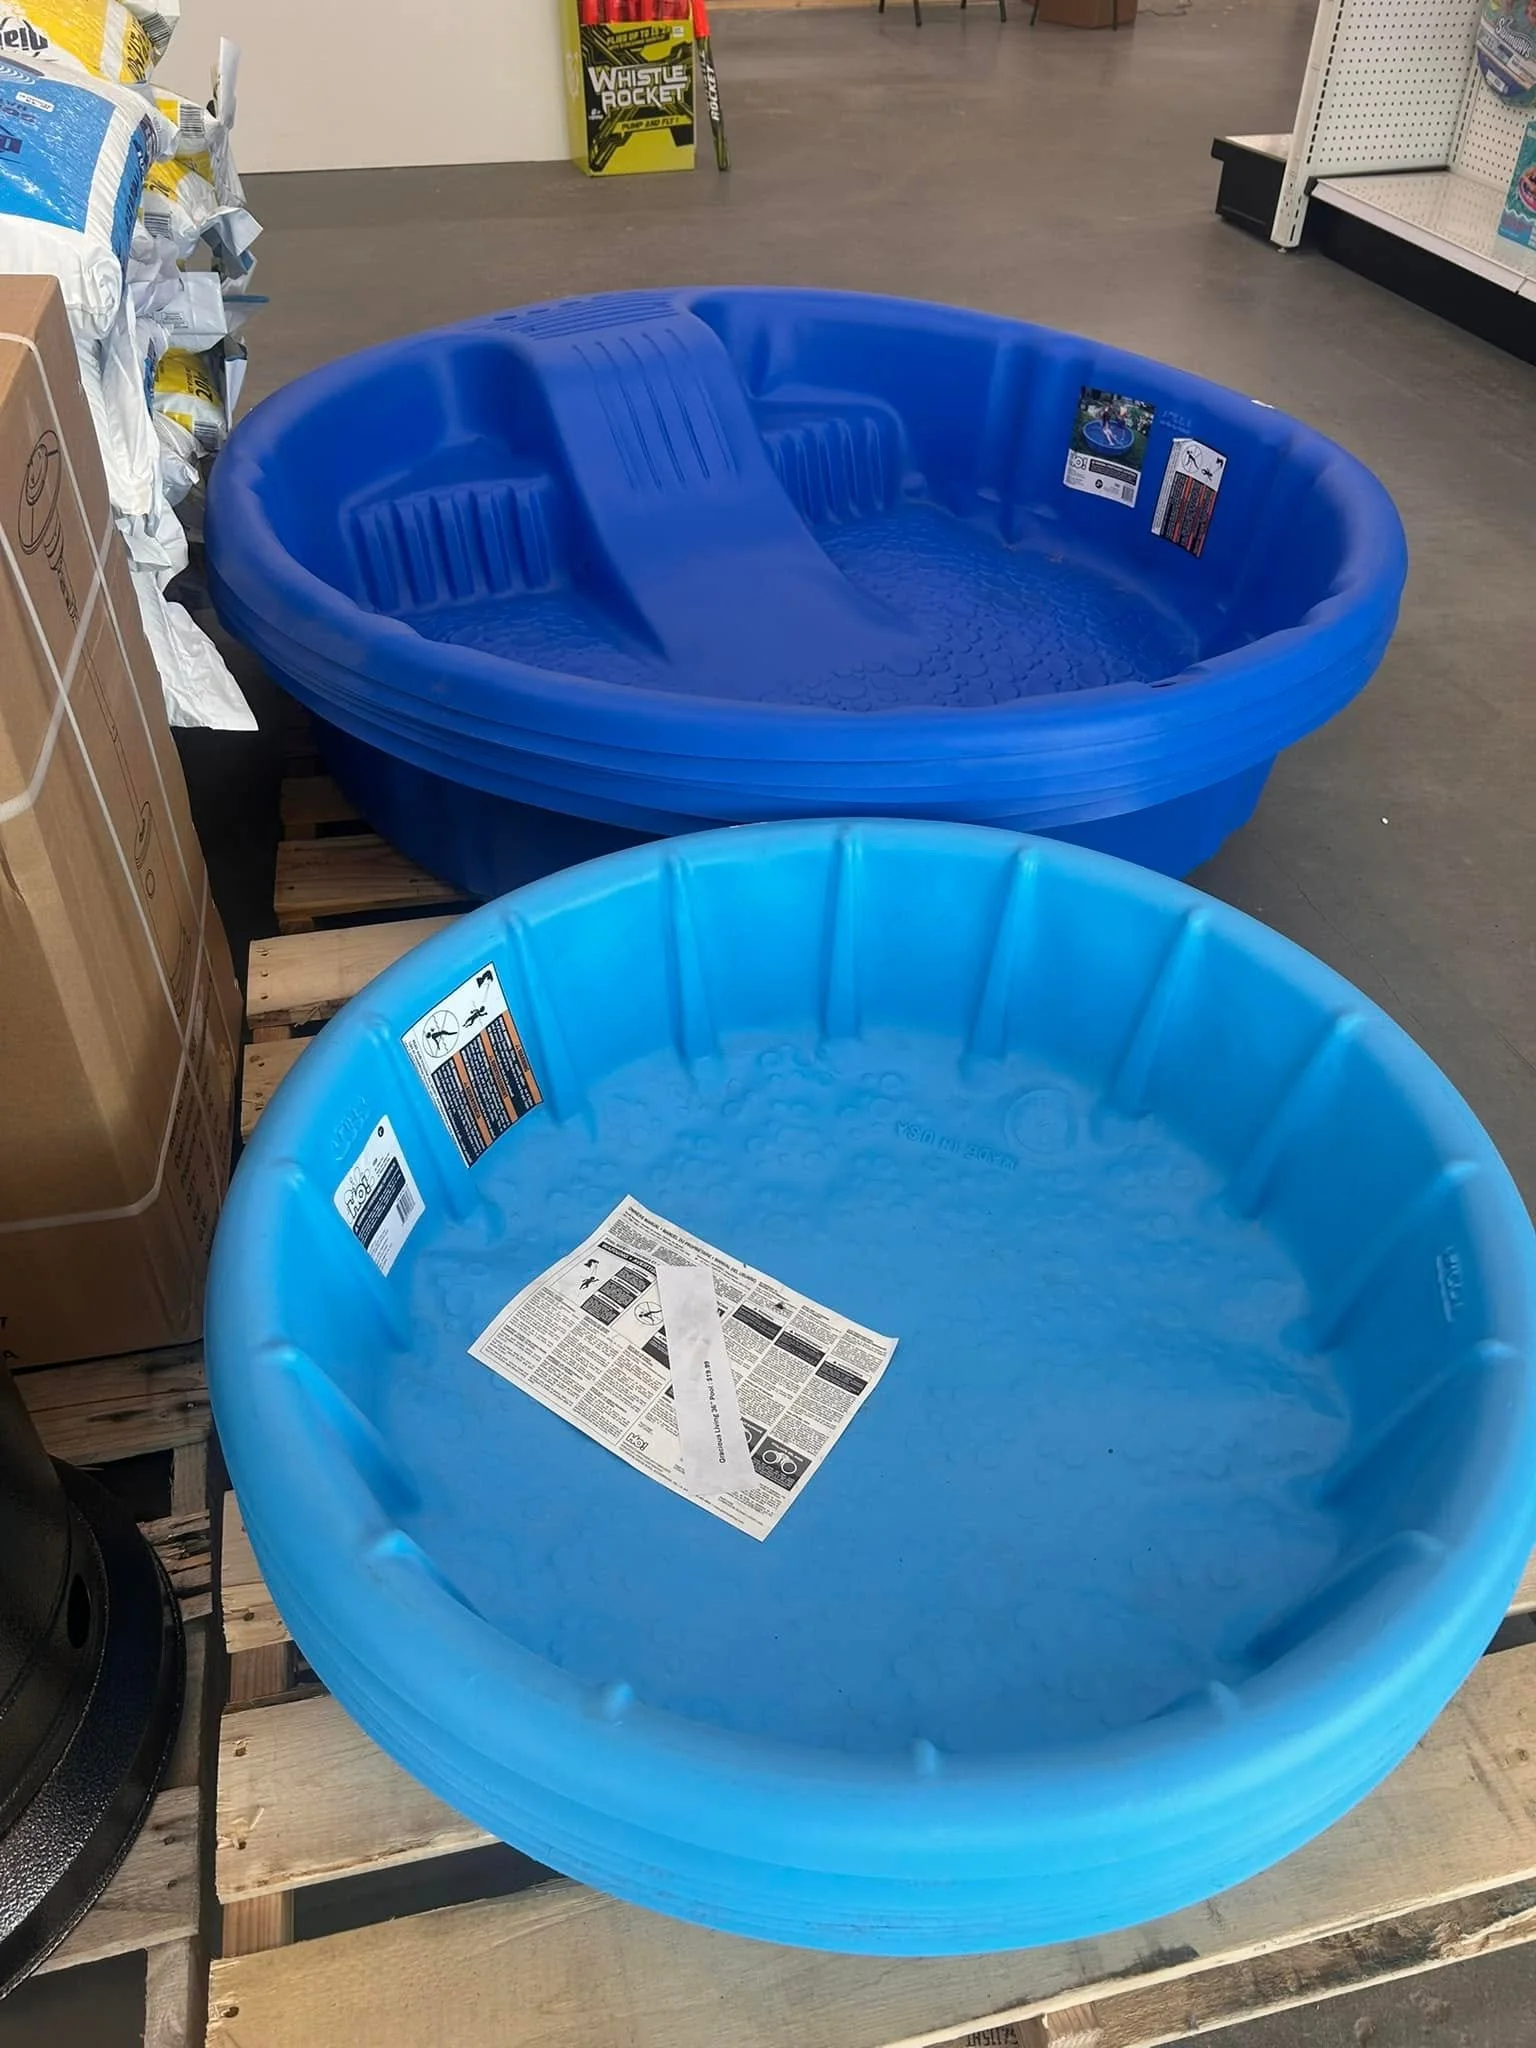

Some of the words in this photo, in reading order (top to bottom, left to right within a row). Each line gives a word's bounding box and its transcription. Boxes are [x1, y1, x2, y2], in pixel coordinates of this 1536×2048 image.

[588, 64, 688, 92] WHISTLE
[707, 64, 720, 121] ROCKET
[602, 83, 687, 114] ROCKET
[624, 1431, 650, 1452] HO!
[716, 1434, 726, 1463] Gracious
